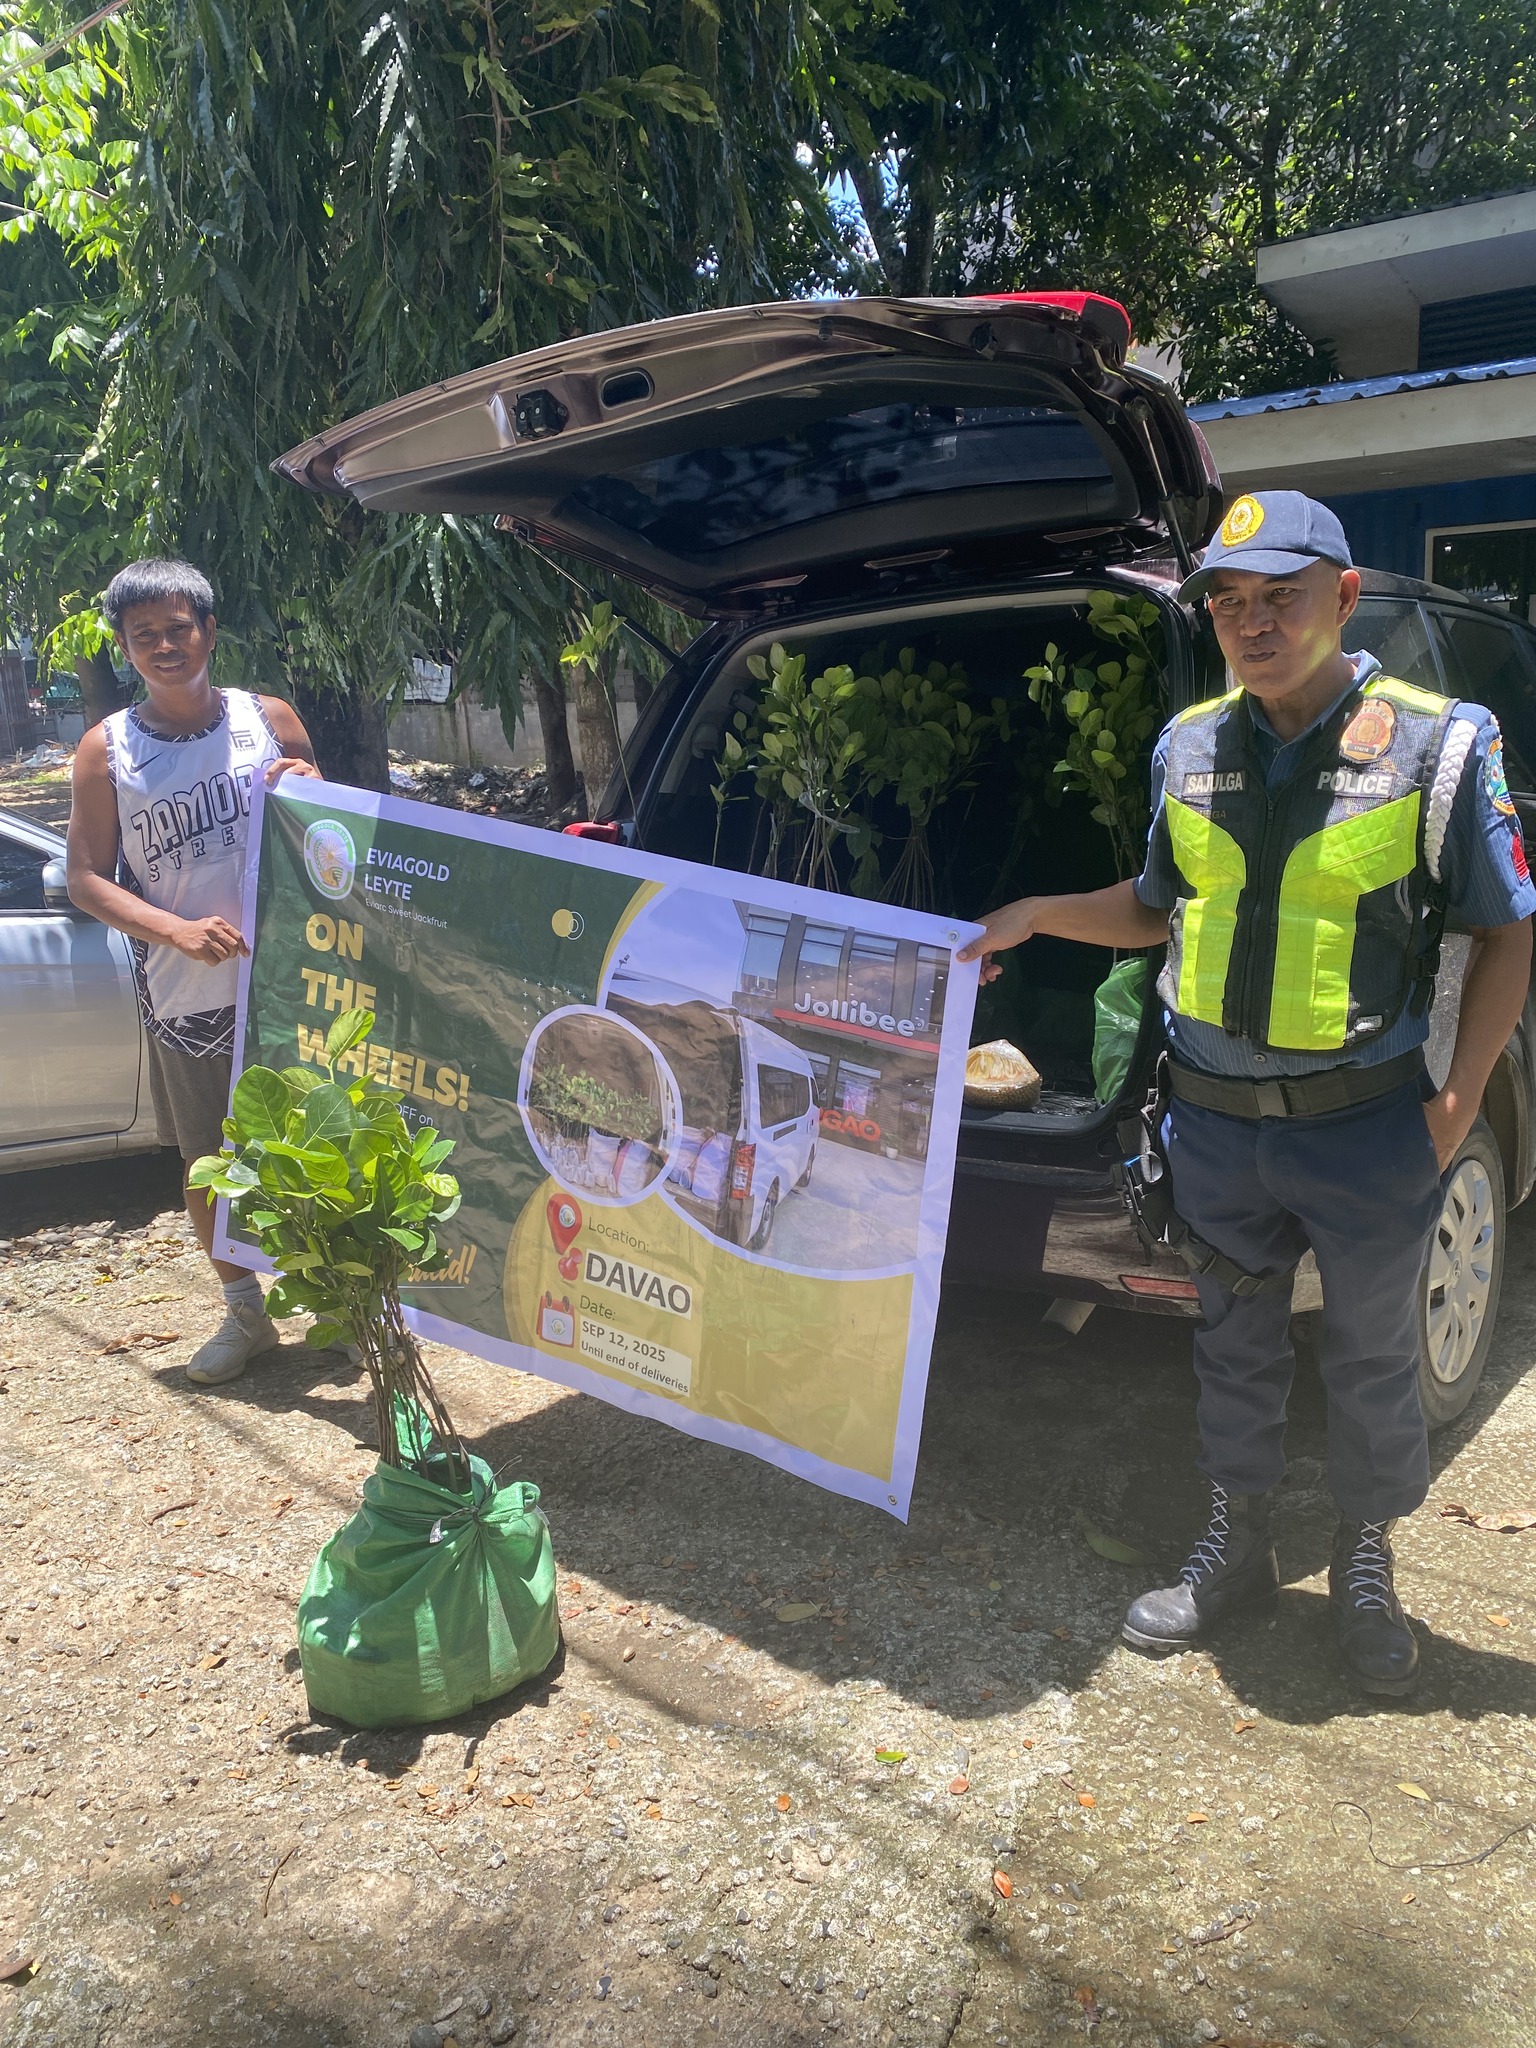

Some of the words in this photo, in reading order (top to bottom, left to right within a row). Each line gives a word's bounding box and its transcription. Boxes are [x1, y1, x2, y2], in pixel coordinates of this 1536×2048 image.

[1187, 772, 1243, 793] SAJULGA
[1317, 771, 1394, 795] POLICE
[131, 758, 276, 864] ZAMOR
[366, 847, 450, 882] EVIAGOLD
[364, 873, 412, 900] LEYTE
[365, 897, 387, 912] Eviarc
[388, 905, 412, 919] Sweet
[412, 912, 448, 929] Jackfruit
[305, 913, 363, 961] ON
[301, 967, 376, 1018] THE
[794, 992, 915, 1037] Jollibee
[297, 1023, 470, 1112] WHEELS!
[419, 1114, 433, 1127] on
[588, 1216, 650, 1253] Location:
[586, 1252, 691, 1314] DAVAO
[580, 1294, 616, 1321] Date:
[582, 1320, 605, 1338] SEP
[609, 1331, 629, 1351] 12,
[632, 1340, 666, 1362] 2025
[581, 1340, 604, 1359] Until
[606, 1353, 625, 1367] end
[628, 1361, 639, 1371] of
[641, 1365, 689, 1393] deliveries
